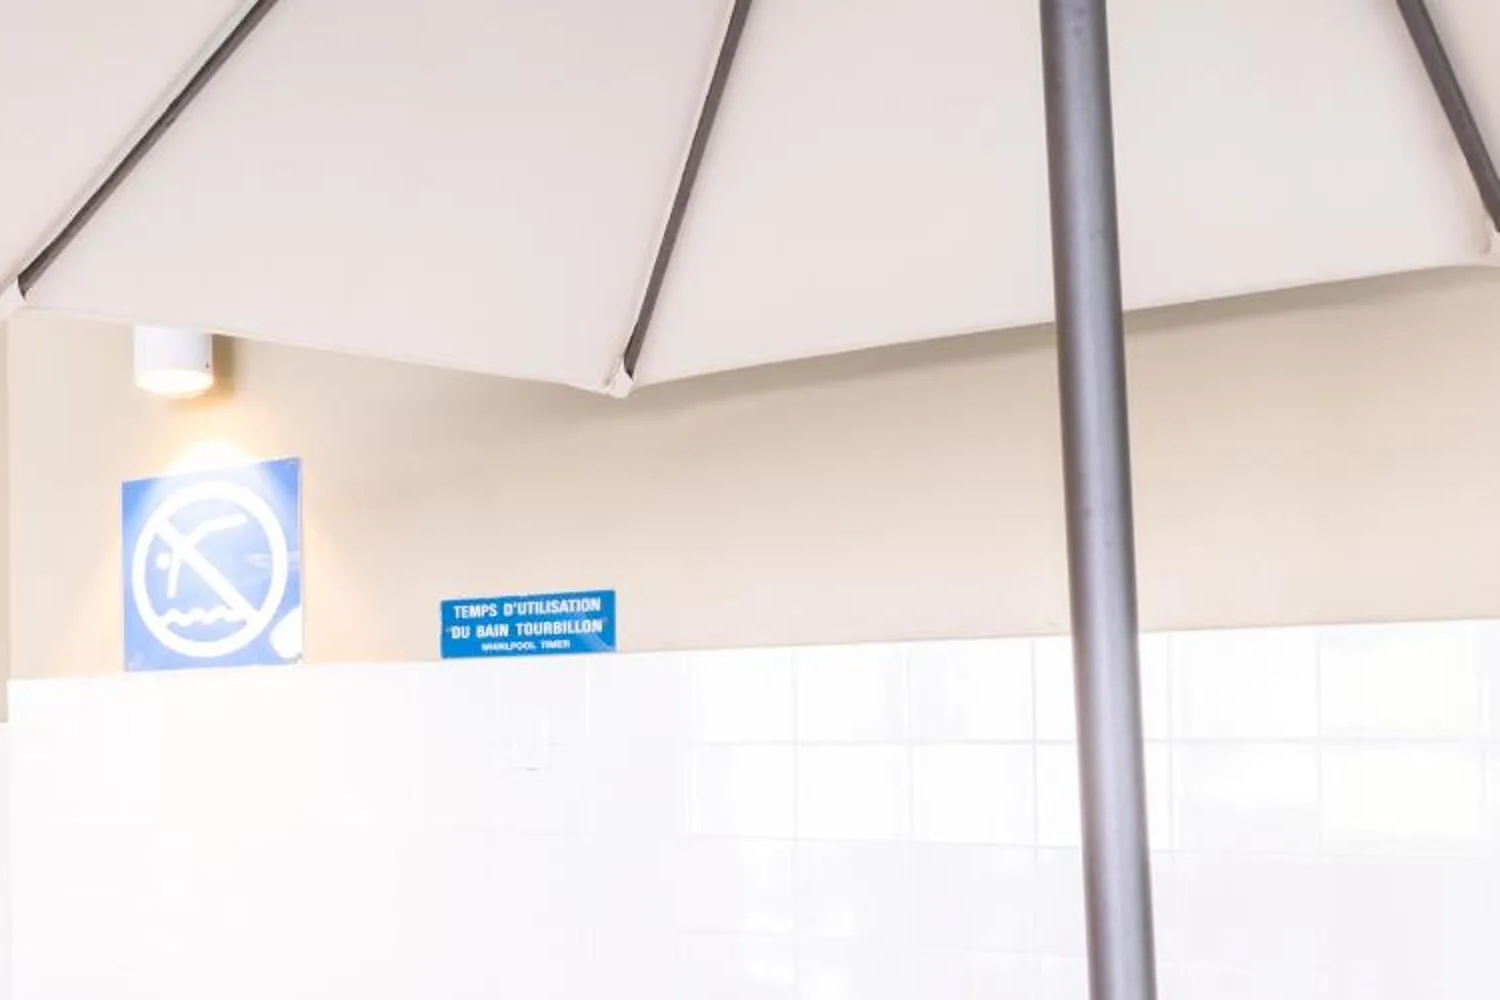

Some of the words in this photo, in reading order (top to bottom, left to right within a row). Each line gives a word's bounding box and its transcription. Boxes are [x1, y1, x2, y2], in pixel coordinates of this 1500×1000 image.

[453, 603, 498, 619] TEMPS
[503, 597, 601, 617] D'UTILISATION
[451, 625, 471, 639] DU
[476, 623, 509, 638] BAIN
[515, 619, 603, 636] TOURBILLON
